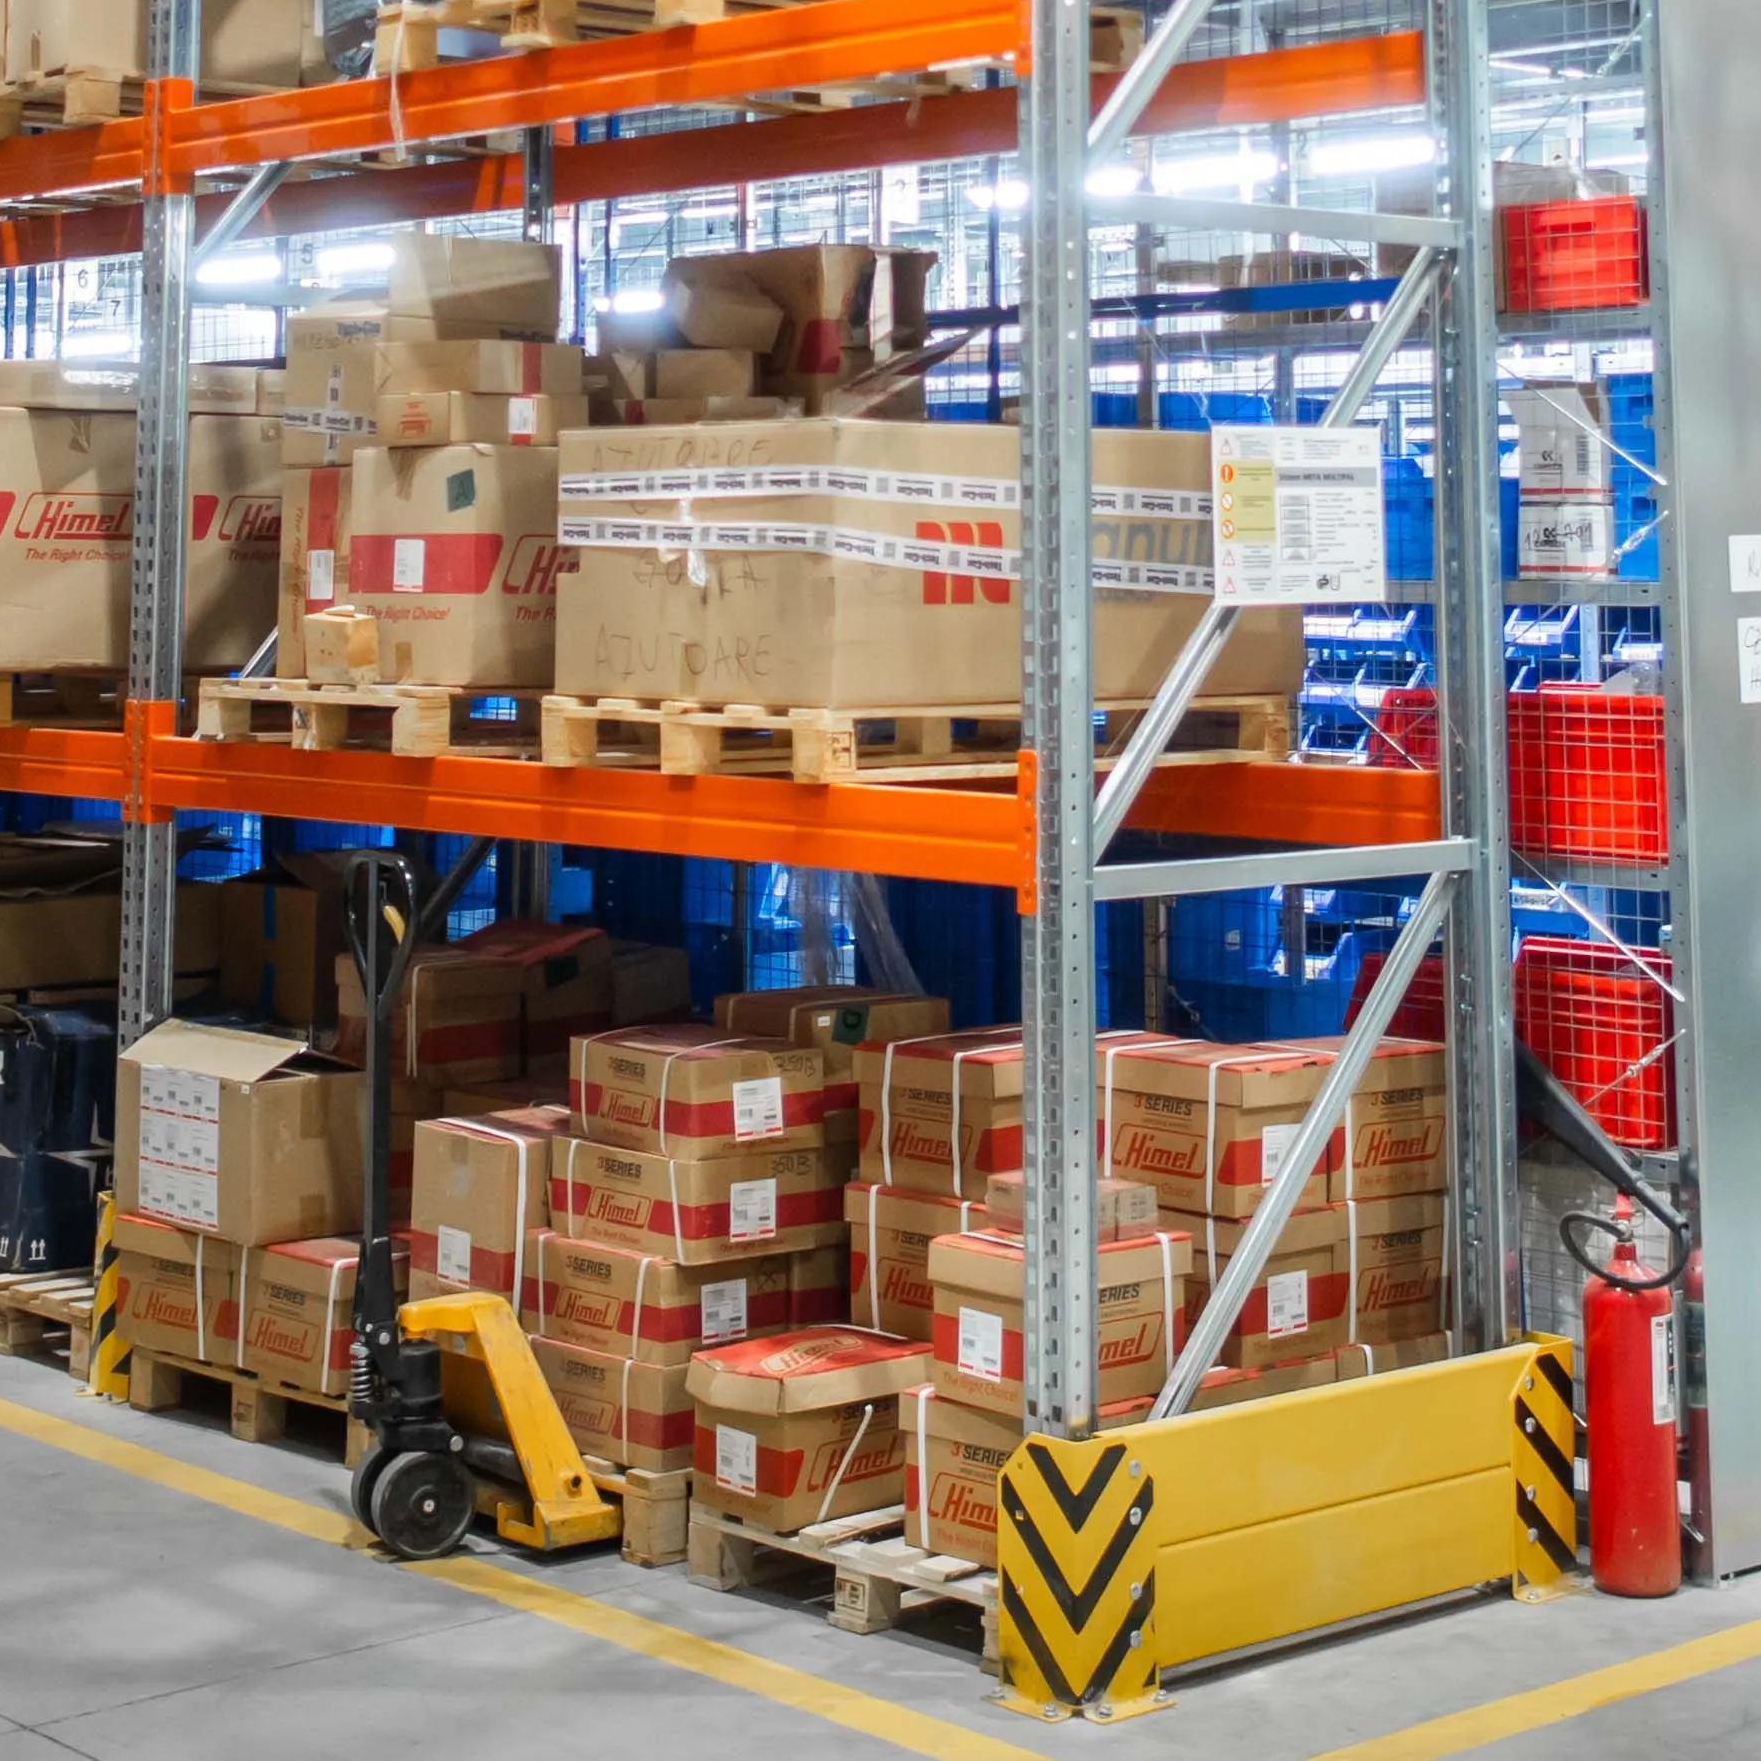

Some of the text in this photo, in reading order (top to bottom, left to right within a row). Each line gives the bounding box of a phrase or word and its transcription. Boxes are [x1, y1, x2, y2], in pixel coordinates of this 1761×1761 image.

[301, 242, 313, 265] 5
[77, 268, 87, 289] 6
[109, 299, 120, 317] 7
[37, 501, 128, 540] Himel
[25, 548, 130, 562] The Right Choice!
[613, 1057, 646, 1077] SERIES
[608, 1092, 646, 1122] Himel
[908, 1088, 951, 1105] SERIES
[1135, 1094, 1192, 1116] 3 SERIES
[1371, 1089, 1423, 1106] 3 SERIES
[1126, 1132, 1198, 1173] Himel
[1365, 1132, 1429, 1168] Himel
[605, 1159, 642, 1177] SERIES
[597, 1191, 640, 1223] Himel
[1372, 1232, 1422, 1251] 3 SERIES
[573, 1256, 612, 1278] SERIES
[269, 1284, 306, 1307] SERIES
[1364, 1276, 1427, 1312] Himel
[565, 1292, 609, 1324] Himel
[256, 1316, 308, 1355] Himel
[566, 1360, 606, 1382] SERIES
[943, 1371, 1020, 1401] The Right Choice!
[951, 1441, 960, 1456] 3
[947, 1482, 998, 1526] Him
